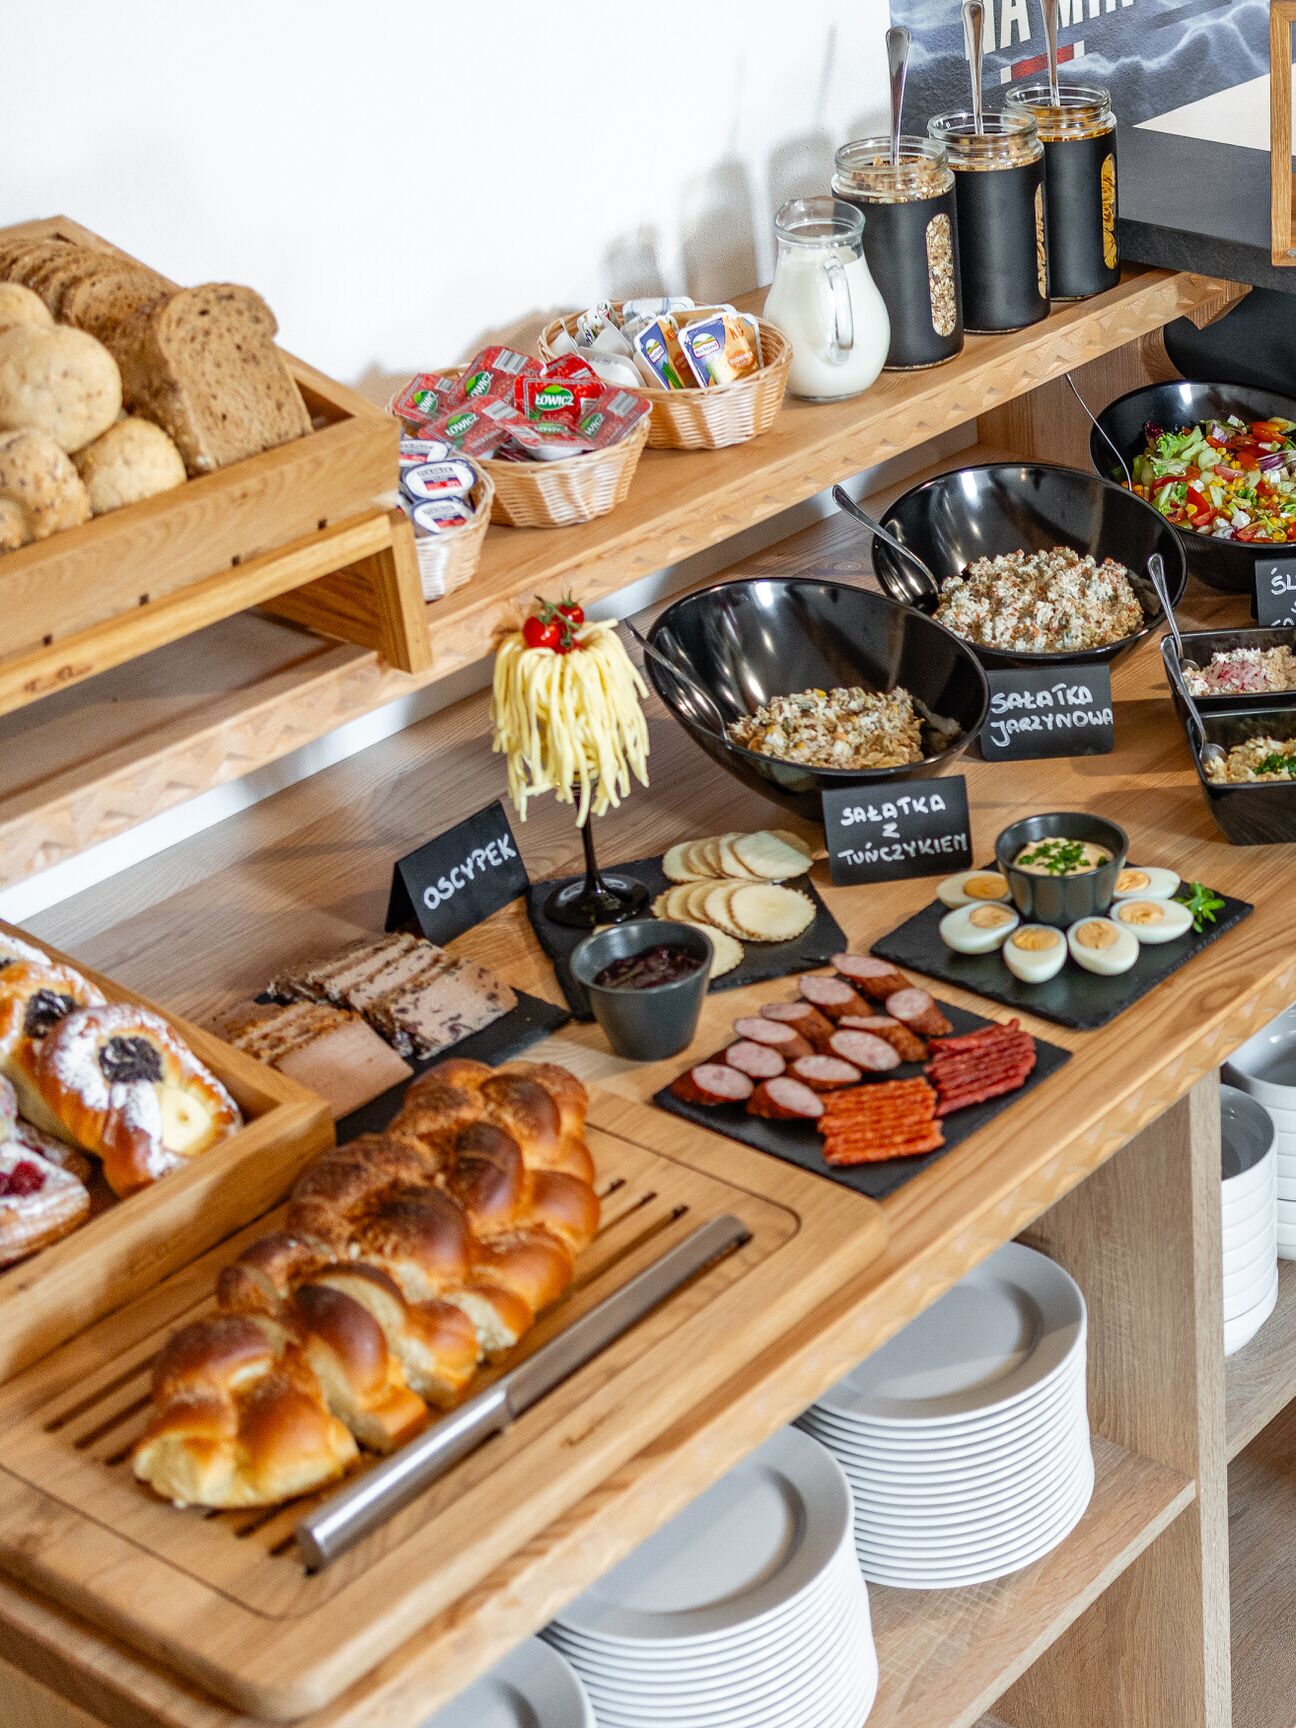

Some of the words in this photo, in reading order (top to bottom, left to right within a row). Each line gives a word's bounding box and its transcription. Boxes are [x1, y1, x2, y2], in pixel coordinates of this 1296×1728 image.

[470, 371, 495, 397] OWICZ
[990, 683, 1094, 715] SAŁATKA
[990, 707, 1114, 748] JARZYNOWA
[840, 793, 946, 827] SAŁATKA
[837, 832, 968, 866] TUŃCZYKIEM
[423, 833, 517, 910] OSCYPEK
